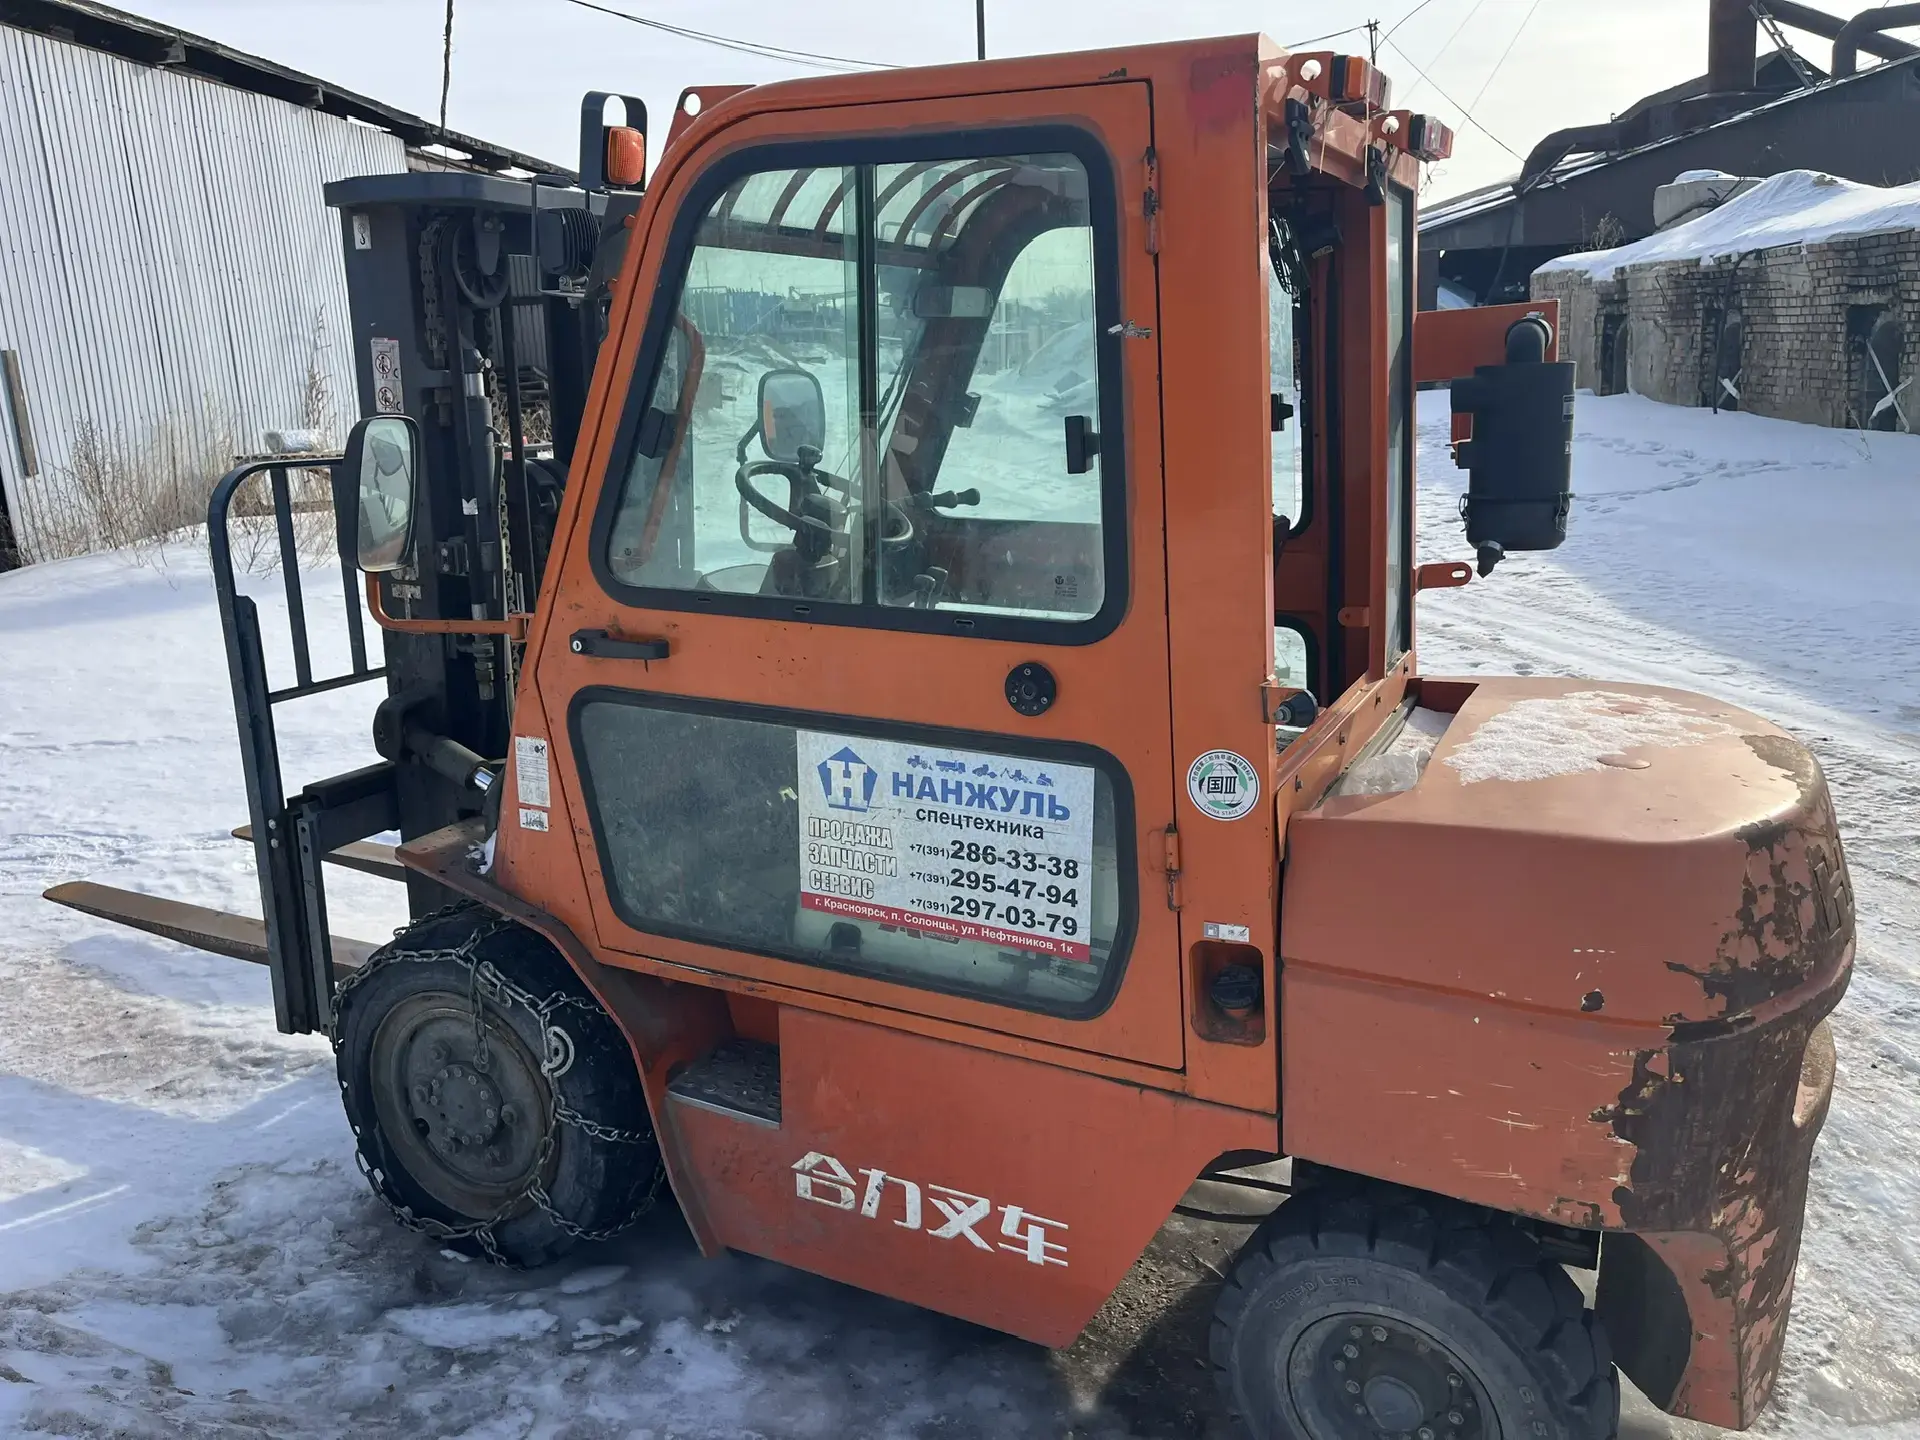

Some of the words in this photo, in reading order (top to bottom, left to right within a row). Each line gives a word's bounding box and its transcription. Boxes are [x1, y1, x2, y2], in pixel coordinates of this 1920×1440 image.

[892, 771, 1071, 821] НАНЖУЛЬ
[1203, 803, 1220, 815] CHINA
[1221, 808, 1239, 816] STAGE
[808, 816, 893, 850] ПРОДАЖА
[916, 807, 1044, 840] спецтехника
[808, 842, 898, 877] ЗАПЧАСТИ
[909, 839, 1079, 879] +7(391)286-33-38
[809, 869, 875, 899] СЕРВИС
[909, 868, 1079, 908] +7(391)295-47-94
[824, 897, 889, 919] Красноярск,
[891, 911, 901, 920] п.
[903, 912, 958, 933] Солонцы,
[961, 925, 978, 936] ул.
[981, 929, 1057, 952] Нефтяников,
[1060, 943, 1074, 954] 1к
[909, 895, 1078, 936] +7(391)297-03-79
[791, 1151, 1069, 1267] 合力叉车
